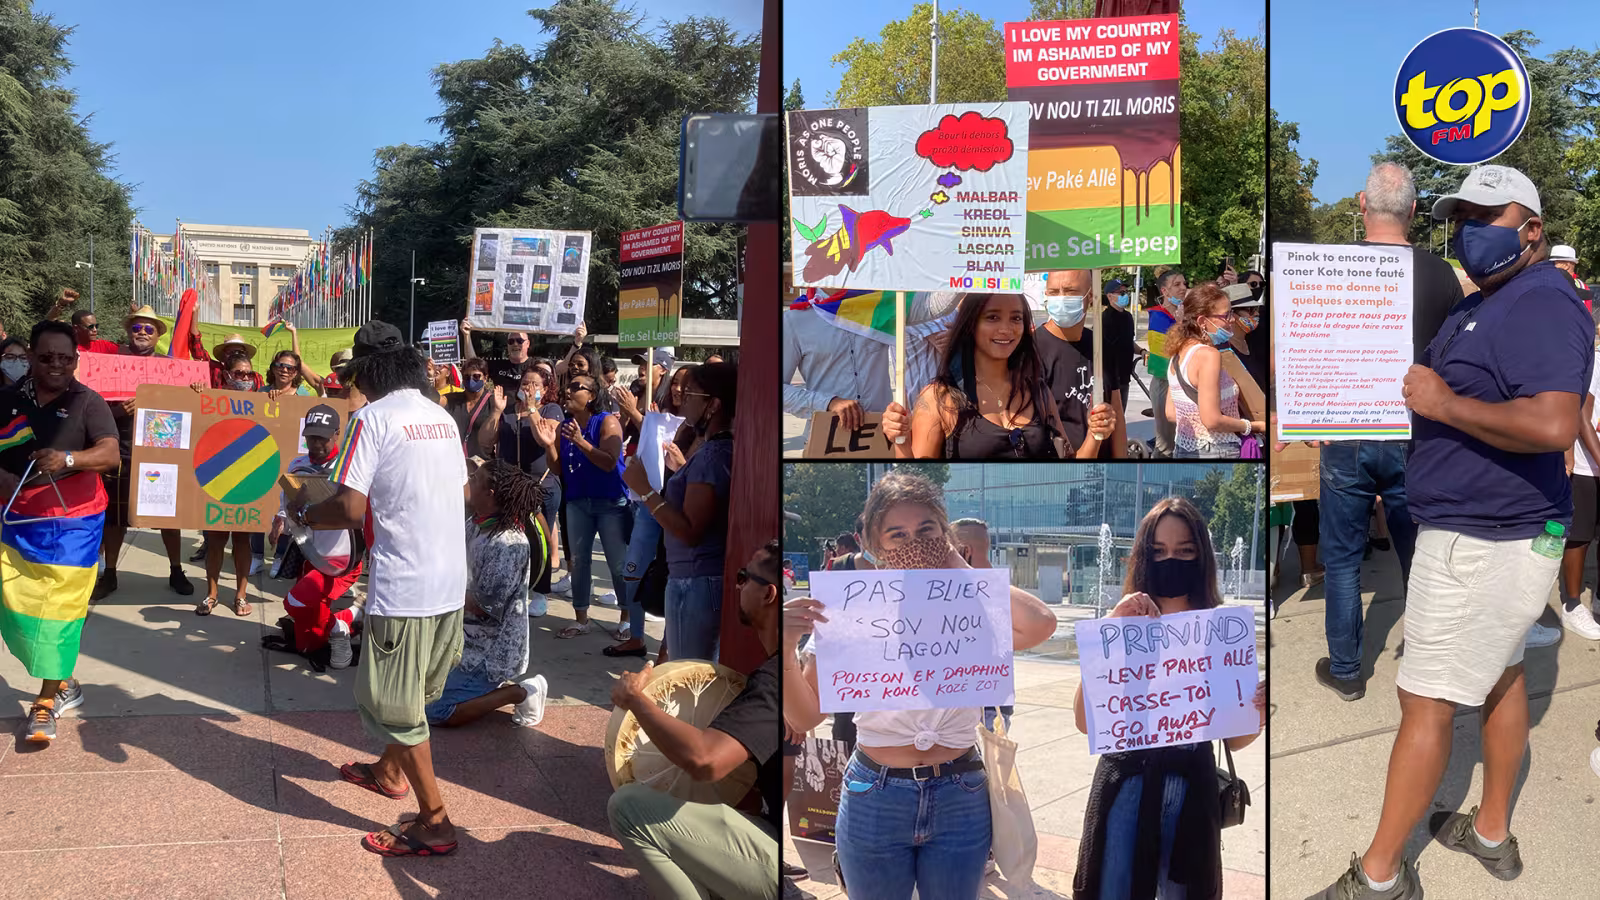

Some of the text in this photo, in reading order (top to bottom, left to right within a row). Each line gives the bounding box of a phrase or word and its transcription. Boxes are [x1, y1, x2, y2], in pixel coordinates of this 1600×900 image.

[1012, 21, 1171, 42] I LOVE MY COUNTRY
[1013, 41, 1171, 62] IM ASHAMED OF MY
[1038, 63, 1148, 81] GOVERNMENT
[1028, 95, 1175, 120] OV NOU TI ZIL MORIS
[938, 132, 960, 140] Bour
[969, 130, 1000, 139] dehors
[797, 119, 862, 185] MORIS AS ONE PEOPLE
[961, 145, 1005, 154] démission
[1026, 168, 1117, 191] ev Paké Allé
[956, 191, 1019, 203] MALBAR
[963, 208, 1011, 221] KREOL
[626, 232, 641, 242] LOVE
[642, 230, 652, 239] MY
[652, 224, 681, 236] COUNTRY
[961, 226, 1012, 238] SINWA
[623, 233, 681, 251] IM ASHAMED OF MY
[958, 243, 1015, 255] LASCAR
[1068, 234, 1100, 257] Sel
[1109, 234, 1178, 257] Lepep
[631, 245, 672, 258] GOVERNMENT
[1288, 252, 1400, 265] Pinok to encore pas
[621, 260, 681, 278] SOV NOU TI ZIL MORIS
[966, 260, 1005, 272] BLAN
[1282, 267, 1405, 278] coner Kote tone fauté
[949, 276, 1022, 289] MORISIEN
[1289, 281, 1399, 293] Laisse mo donne toi
[1292, 295, 1342, 307] quelques
[1292, 310, 1303, 318] To
[1304, 312, 1324, 320] pan
[1325, 311, 1357, 320] protez
[1383, 313, 1407, 322] pays
[1300, 321, 1322, 329] laisse
[1332, 322, 1360, 331] drogue
[1361, 322, 1380, 330] faire
[620, 329, 679, 342] Ene Sel Lepep
[1290, 331, 1331, 339] Nepotisme
[200, 394, 255, 416] BOUR
[1303, 400, 1325, 408] prend
[307, 413, 332, 425] UFC
[402, 423, 457, 441] MAURITIUS
[205, 502, 261, 526] DEOR
[843, 580, 991, 611] PAS BLIER
[941, 614, 982, 635] NOU
[1108, 645, 1255, 685] LEVE PAKET ALLÉ
[832, 663, 1010, 687] POISSON EK DAUPHINS
[837, 686, 871, 701] PAS
[882, 684, 920, 700] KONE
[975, 679, 1000, 692] ZOT
[1111, 708, 1216, 738] GO AWAY
[1165, 730, 1193, 744] JAO
